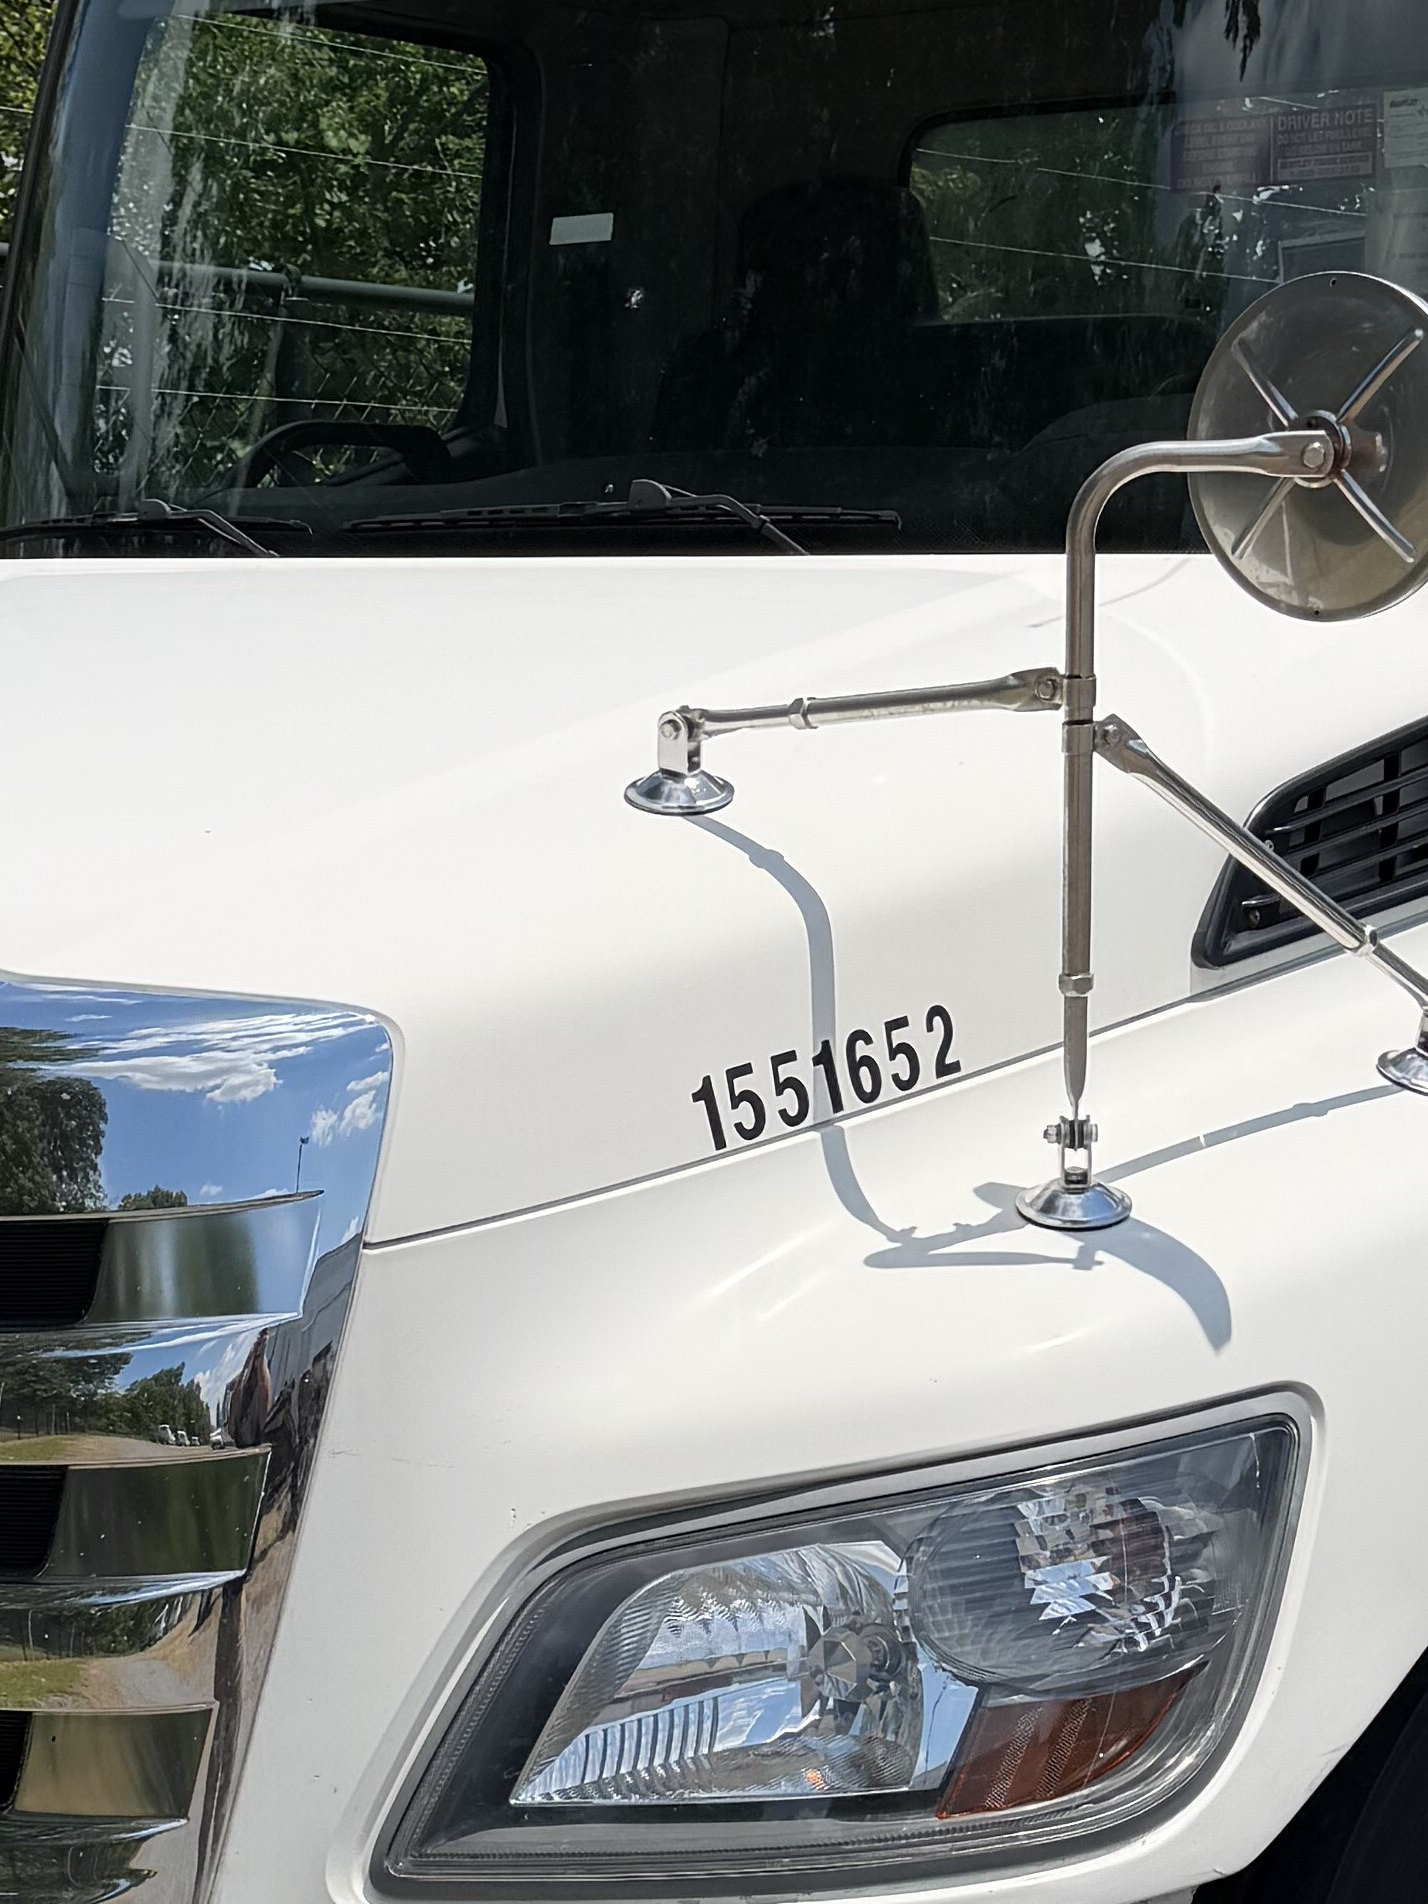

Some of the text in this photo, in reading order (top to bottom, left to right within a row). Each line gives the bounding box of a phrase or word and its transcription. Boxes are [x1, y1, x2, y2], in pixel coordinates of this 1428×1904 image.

[1278, 108, 1375, 130] DRIVER NOTE
[691, 1004, 961, 1151] 1551652
